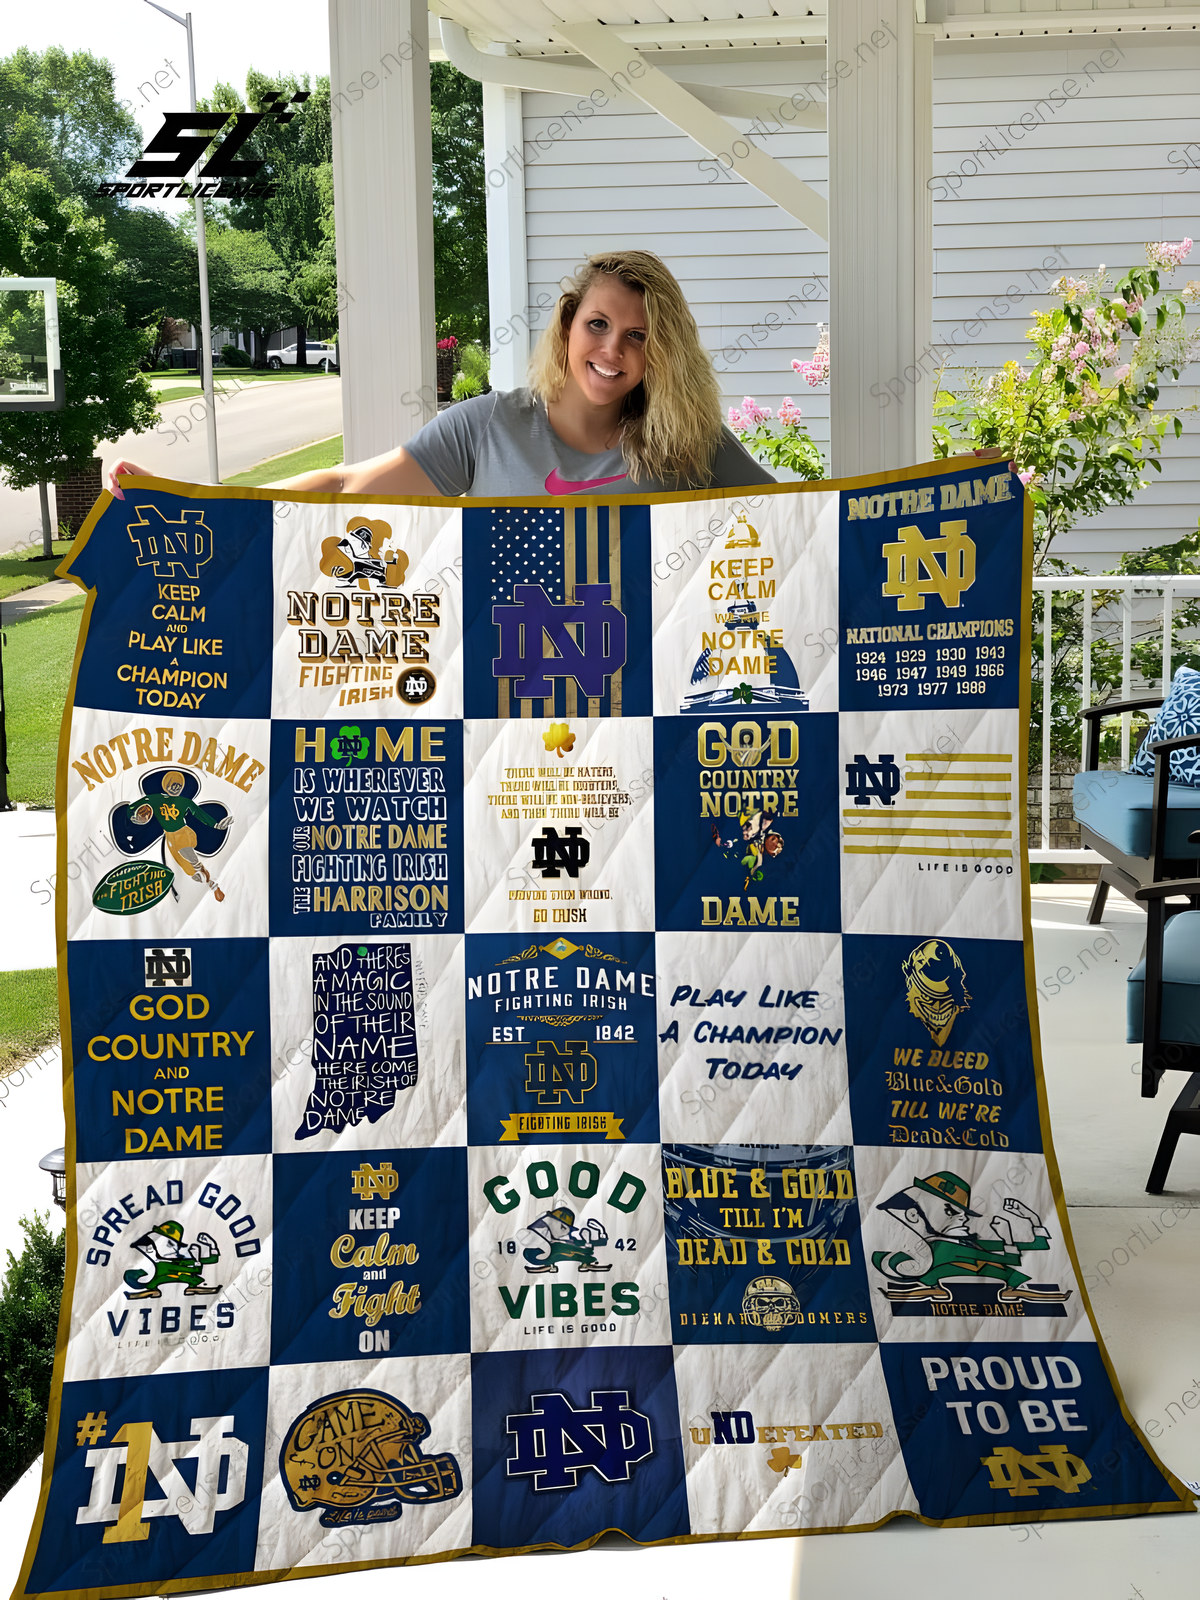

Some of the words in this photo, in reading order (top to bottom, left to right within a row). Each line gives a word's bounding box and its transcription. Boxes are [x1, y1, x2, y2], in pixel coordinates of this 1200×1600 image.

[940, 472, 1013, 511] DAME
[710, 557, 774, 579] KEEP
[158, 584, 200, 601] KEEP
[708, 579, 776, 601] CALM
[152, 604, 206, 622] CALM
[287, 591, 441, 627] NOTRE
[128, 630, 177, 653] PLAY
[183, 637, 223, 655] LIKE
[701, 629, 784, 651] NOTRE
[846, 624, 924, 645] NATIONAL
[927, 619, 1014, 641] CHAMPIONS
[298, 628, 430, 664] DAME
[855, 652, 886, 665] 1924
[895, 649, 926, 664] 1929
[936, 647, 967, 662] 1930
[975, 646, 1006, 660] 1943
[170, 656, 179, 667] A
[708, 655, 778, 676] DAME
[856, 668, 887, 682] 1946
[896, 666, 927, 681] 1947
[936, 665, 967, 679] 1949
[975, 663, 1005, 677] 1966
[117, 664, 228, 689] CHAMPION
[299, 666, 393, 688] FIGHTING
[135, 689, 207, 710] TODAY
[339, 686, 394, 707] IRISH
[878, 683, 908, 698] 1973
[917, 682, 948, 696] 1977
[956, 681, 986, 695] 1988
[697, 720, 799, 767] GOD
[71, 727, 174, 792] NOTRE
[178, 727, 266, 793] DAME
[293, 767, 316, 794] IS
[322, 767, 446, 793] WHEREVER
[699, 769, 799, 790] COUNTRY
[293, 796, 335, 822] WE
[345, 796, 447, 822] WATCH
[699, 790, 799, 818] NOTRE
[311, 824, 382, 851] NOTRE
[388, 824, 447, 849] DAME
[292, 854, 387, 882] FIGHTING
[393, 853, 448, 881] IRISH
[974, 864, 1013, 875] GOOD
[120, 879, 163, 912] IRISH
[293, 887, 311, 915] THE
[313, 884, 449, 912] HARRISON
[370, 912, 448, 928] FAMILY
[701, 896, 800, 926] DAME
[314, 948, 352, 971] AND
[314, 973, 327, 992] A
[331, 971, 411, 992] MAGIC
[468, 966, 559, 1000] NOTRE
[576, 966, 655, 997] DAME
[129, 993, 210, 1021] GOD
[314, 994, 329, 1012] IN
[331, 992, 364, 1013] THE
[365, 992, 413, 1011] SOUND
[495, 994, 573, 1013] FIGHTING
[583, 994, 627, 1011] IRISH
[670, 985, 748, 1007] PLAY
[758, 985, 820, 1008] LIKE
[315, 1013, 346, 1035] OF
[347, 1011, 415, 1034] THEIR
[492, 1026, 525, 1042] EST
[596, 1025, 635, 1041] 1842
[659, 1020, 679, 1044] A
[694, 1020, 843, 1046] CHAMPION
[87, 1030, 255, 1062] COUNTRY
[314, 1034, 416, 1061] NAME
[317, 1062, 367, 1075] HERE
[371, 1060, 417, 1074] COME
[706, 1057, 803, 1080] TODAY
[893, 1047, 924, 1067] WE
[928, 1050, 989, 1070] BLEED
[153, 1066, 190, 1080] AND
[316, 1077, 349, 1090] THE
[351, 1075, 400, 1089] IRISH
[401, 1074, 418, 1085] OF
[112, 1086, 224, 1117] NOTRE
[311, 1090, 394, 1108] NOTRE
[306, 1107, 365, 1130] DAME
[519, 1116, 571, 1131] FIGHTING
[577, 1116, 607, 1130] IRISH
[891, 1100, 929, 1119] TILL
[938, 1101, 1002, 1123] WE'RE
[124, 1124, 223, 1154] DAME
[483, 1160, 647, 1215] GOOD
[665, 1167, 739, 1199] BLUE
[750, 1168, 771, 1198] &
[781, 1168, 854, 1199] GOLD
[86, 1180, 184, 1267] SPREAD
[198, 1182, 261, 1258] GOOD
[349, 1207, 400, 1230] KEEP
[719, 1207, 766, 1228] TILL
[773, 1207, 804, 1228] I'M
[330, 1232, 420, 1269] Calm
[497, 1241, 517, 1254] 18
[615, 1238, 637, 1252] 42
[676, 1239, 747, 1265] DEAD
[757, 1239, 776, 1265] &
[785, 1239, 851, 1266] COLD
[363, 1268, 387, 1280] and
[328, 1280, 422, 1327] Fight
[498, 1282, 640, 1319] VIBES
[930, 1303, 980, 1316] NOTRE
[984, 1303, 1025, 1316] DAME
[107, 1302, 235, 1337] VIBES
[524, 1325, 554, 1335] LIFE
[562, 1325, 574, 1334] IS
[581, 1322, 617, 1334] GOOD
[359, 1329, 390, 1353] ON
[921, 1356, 1082, 1392] PROUD
[294, 1401, 386, 1451] GAME
[946, 1401, 1010, 1435] TO
[1018, 1399, 1088, 1433] BE
[317, 1437, 355, 1470] ON
